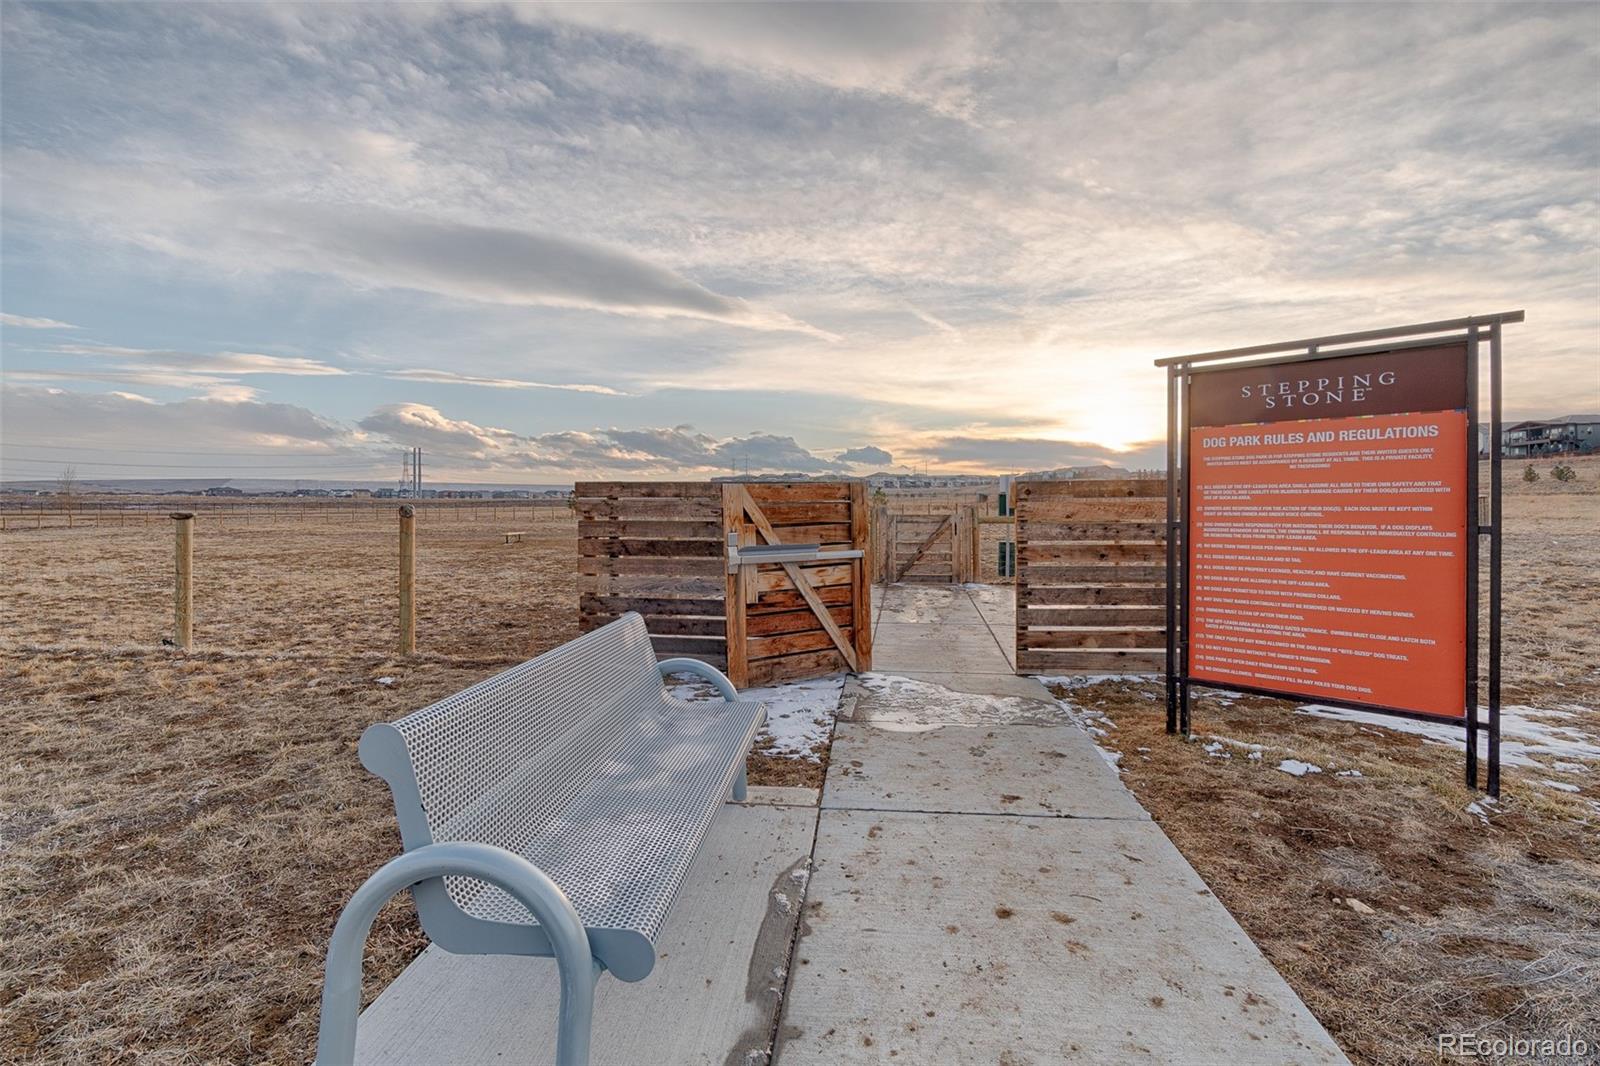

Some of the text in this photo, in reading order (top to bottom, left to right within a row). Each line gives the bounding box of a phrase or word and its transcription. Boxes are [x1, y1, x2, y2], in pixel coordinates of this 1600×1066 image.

[1241, 372, 1396, 398] STEPPING
[1203, 425, 1439, 449] DOG PARK RULES AND REGULATIONS
